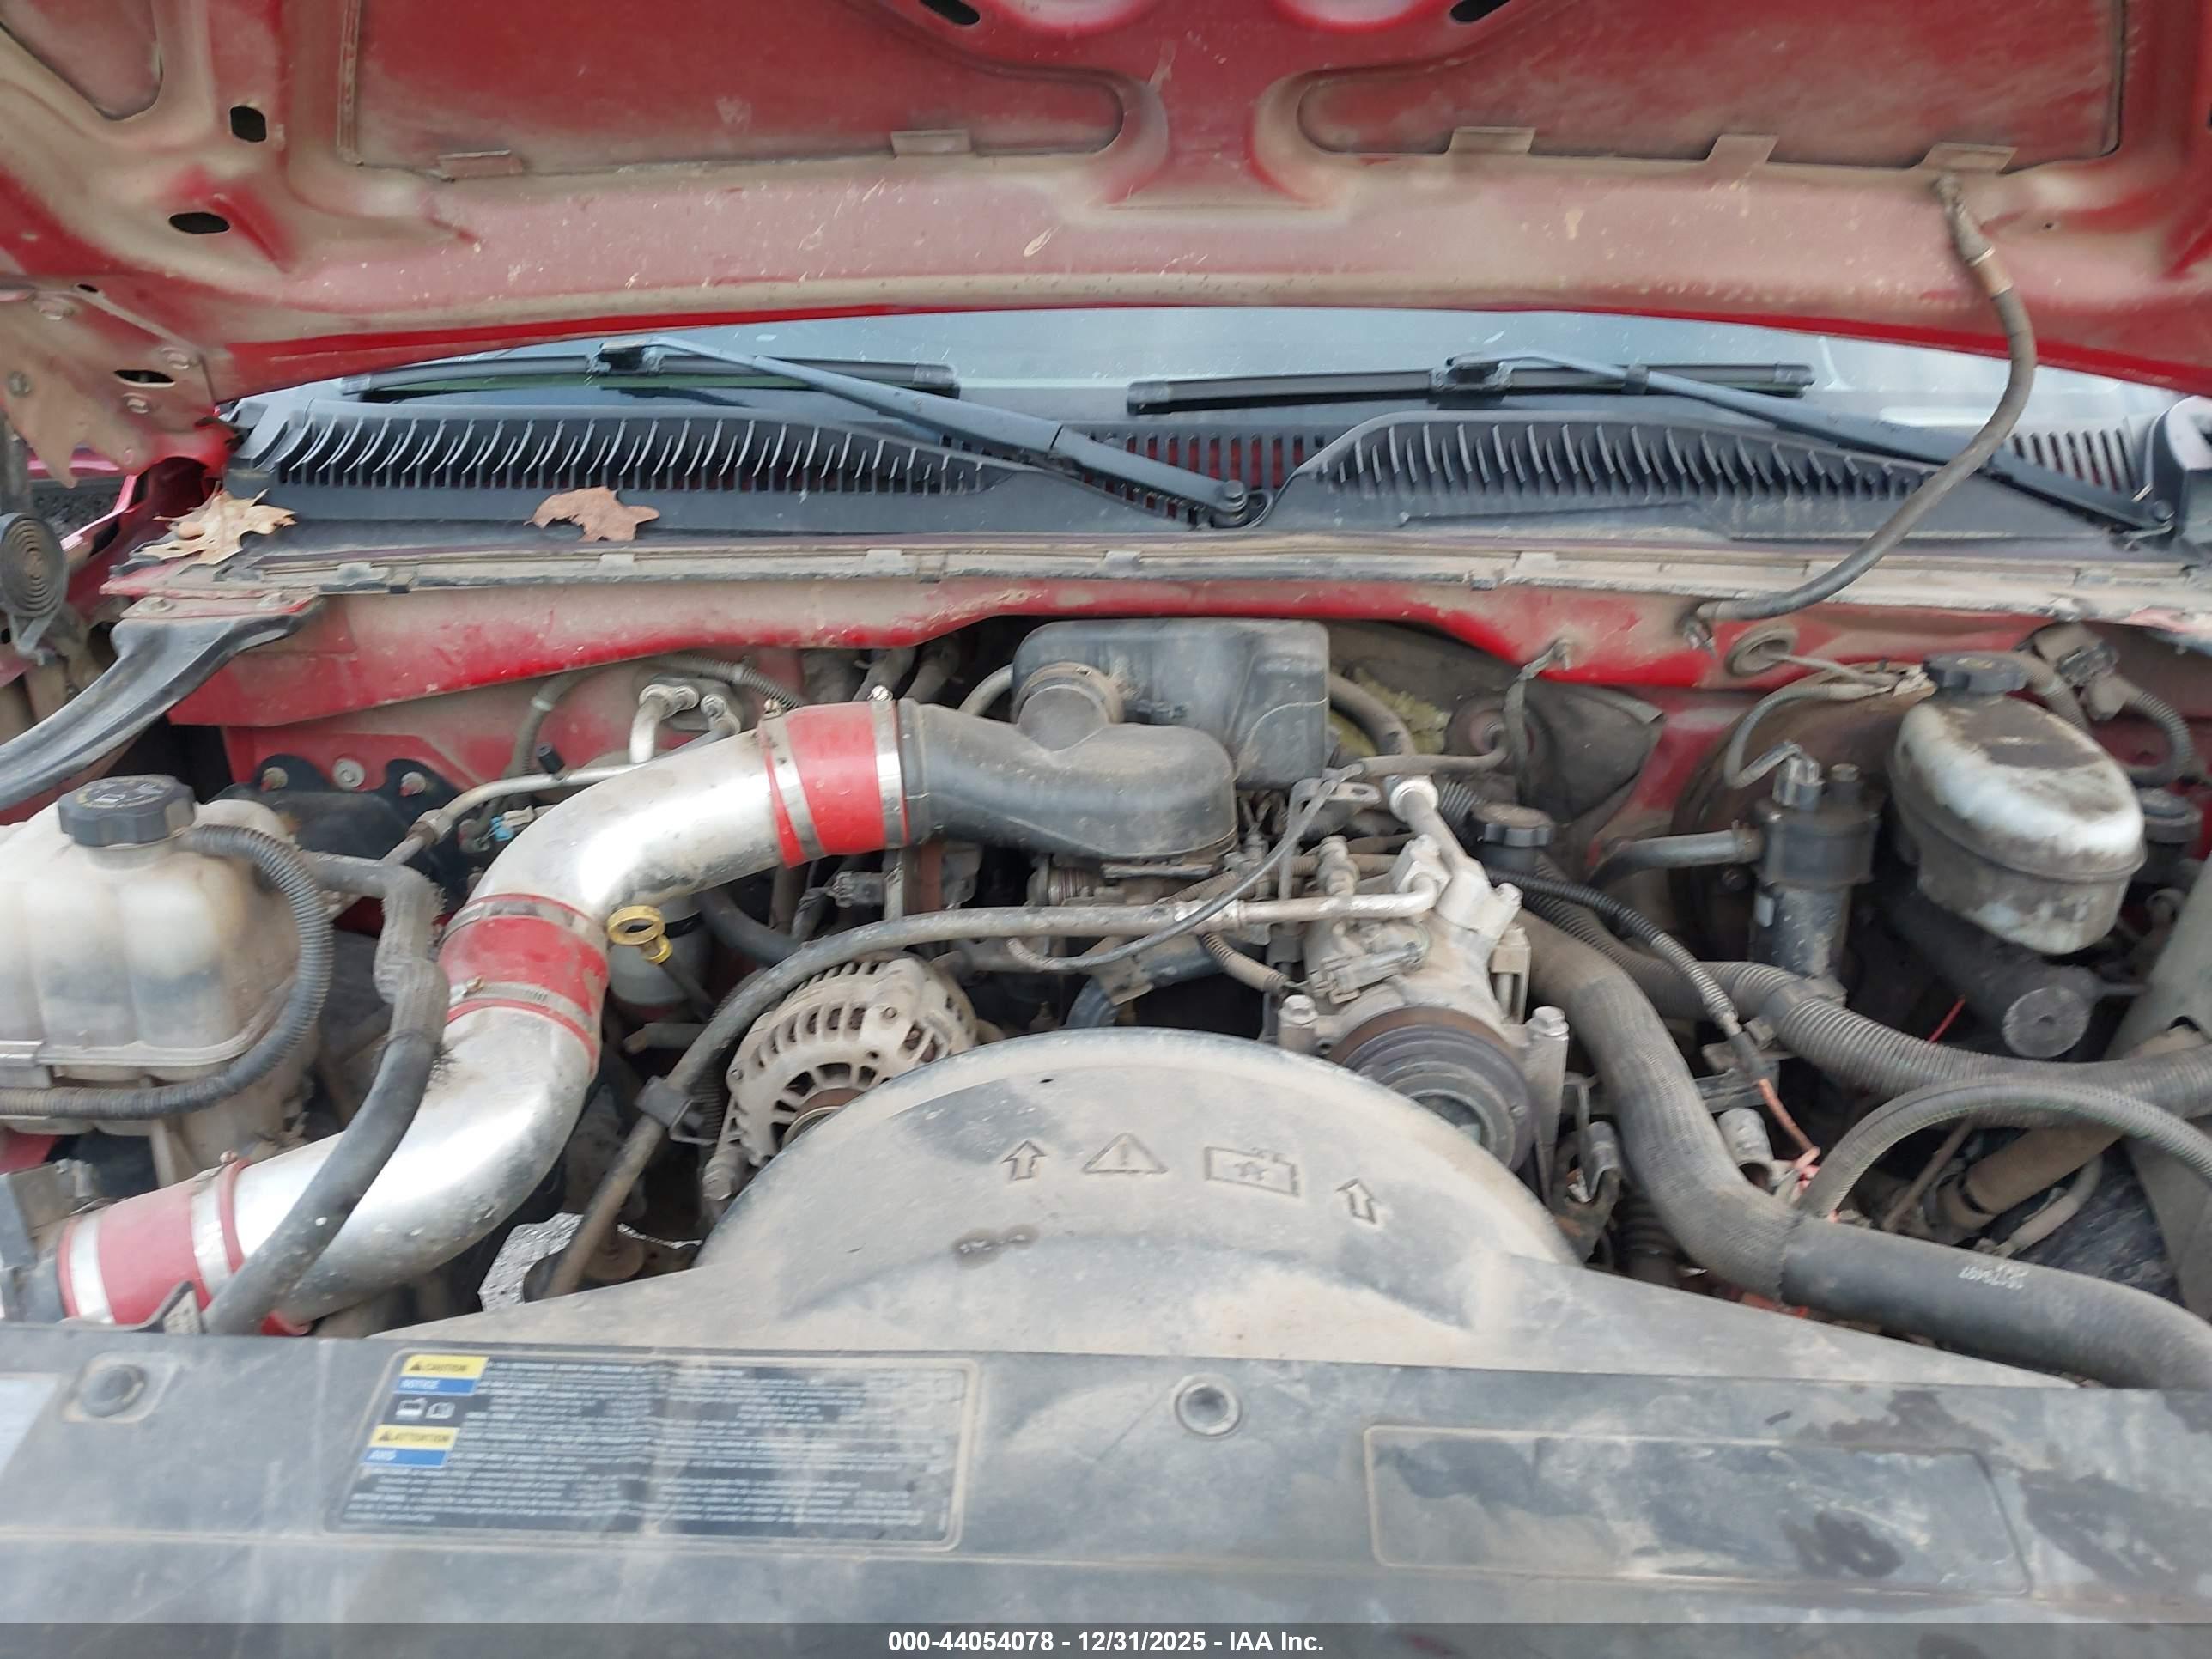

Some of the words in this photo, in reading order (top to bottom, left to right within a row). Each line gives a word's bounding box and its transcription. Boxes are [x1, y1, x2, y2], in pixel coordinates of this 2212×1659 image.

[424, 1364, 468, 1372] CAUTION
[400, 1379, 440, 1389] NOTICE
[392, 1431, 451, 1443] ATTENTION
